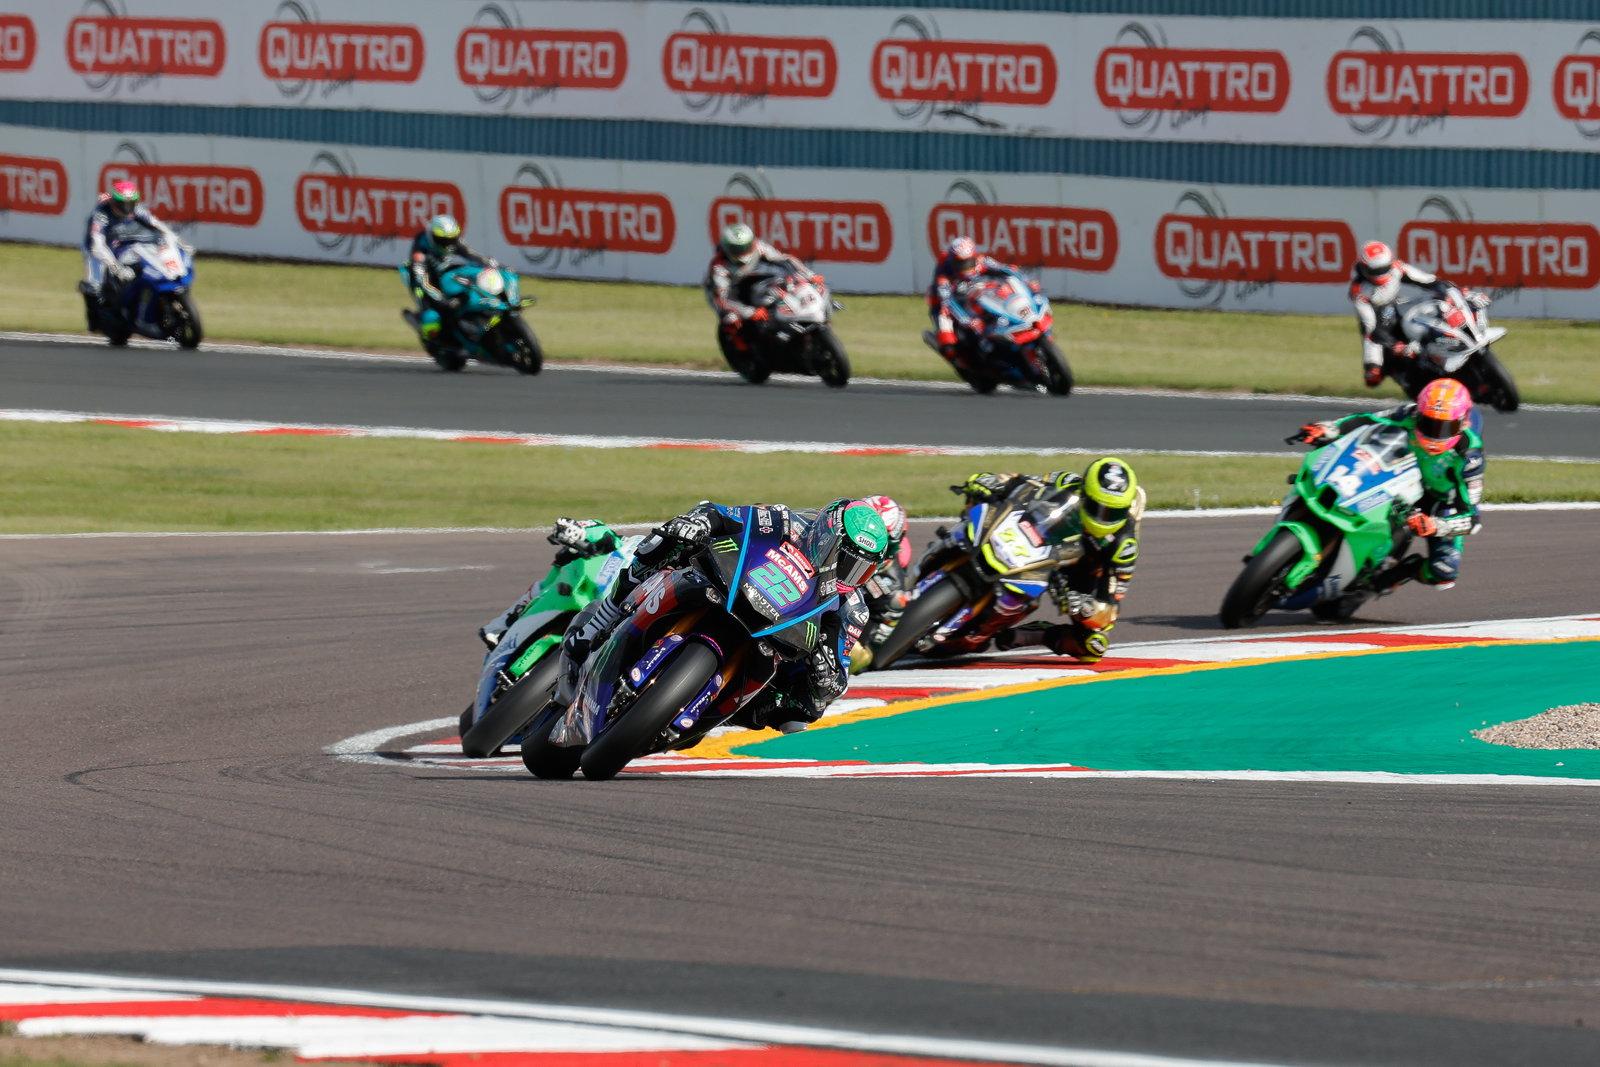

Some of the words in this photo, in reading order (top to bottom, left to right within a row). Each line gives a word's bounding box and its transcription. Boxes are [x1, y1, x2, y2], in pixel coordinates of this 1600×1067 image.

[74, 21, 216, 69] QUATTRO
[267, 26, 413, 76] QUATTRO
[463, 32, 616, 82] QUATTRO
[671, 37, 826, 88] QUATTRO
[879, 45, 1043, 96] QUATTRO
[1105, 52, 1277, 105] QUATTRO
[1336, 57, 1515, 110] QUATTRO
[507, 193, 664, 242] QUATTRO
[935, 210, 1104, 261] QUATTRO
[1164, 220, 1344, 273] QUATTRO
[1407, 228, 1589, 277] QUATTRO
[858, 536, 876, 549] SHOEI
[748, 561, 802, 608] 22
[767, 549, 808, 592] McAMS
[743, 582, 780, 621] MONSTER
